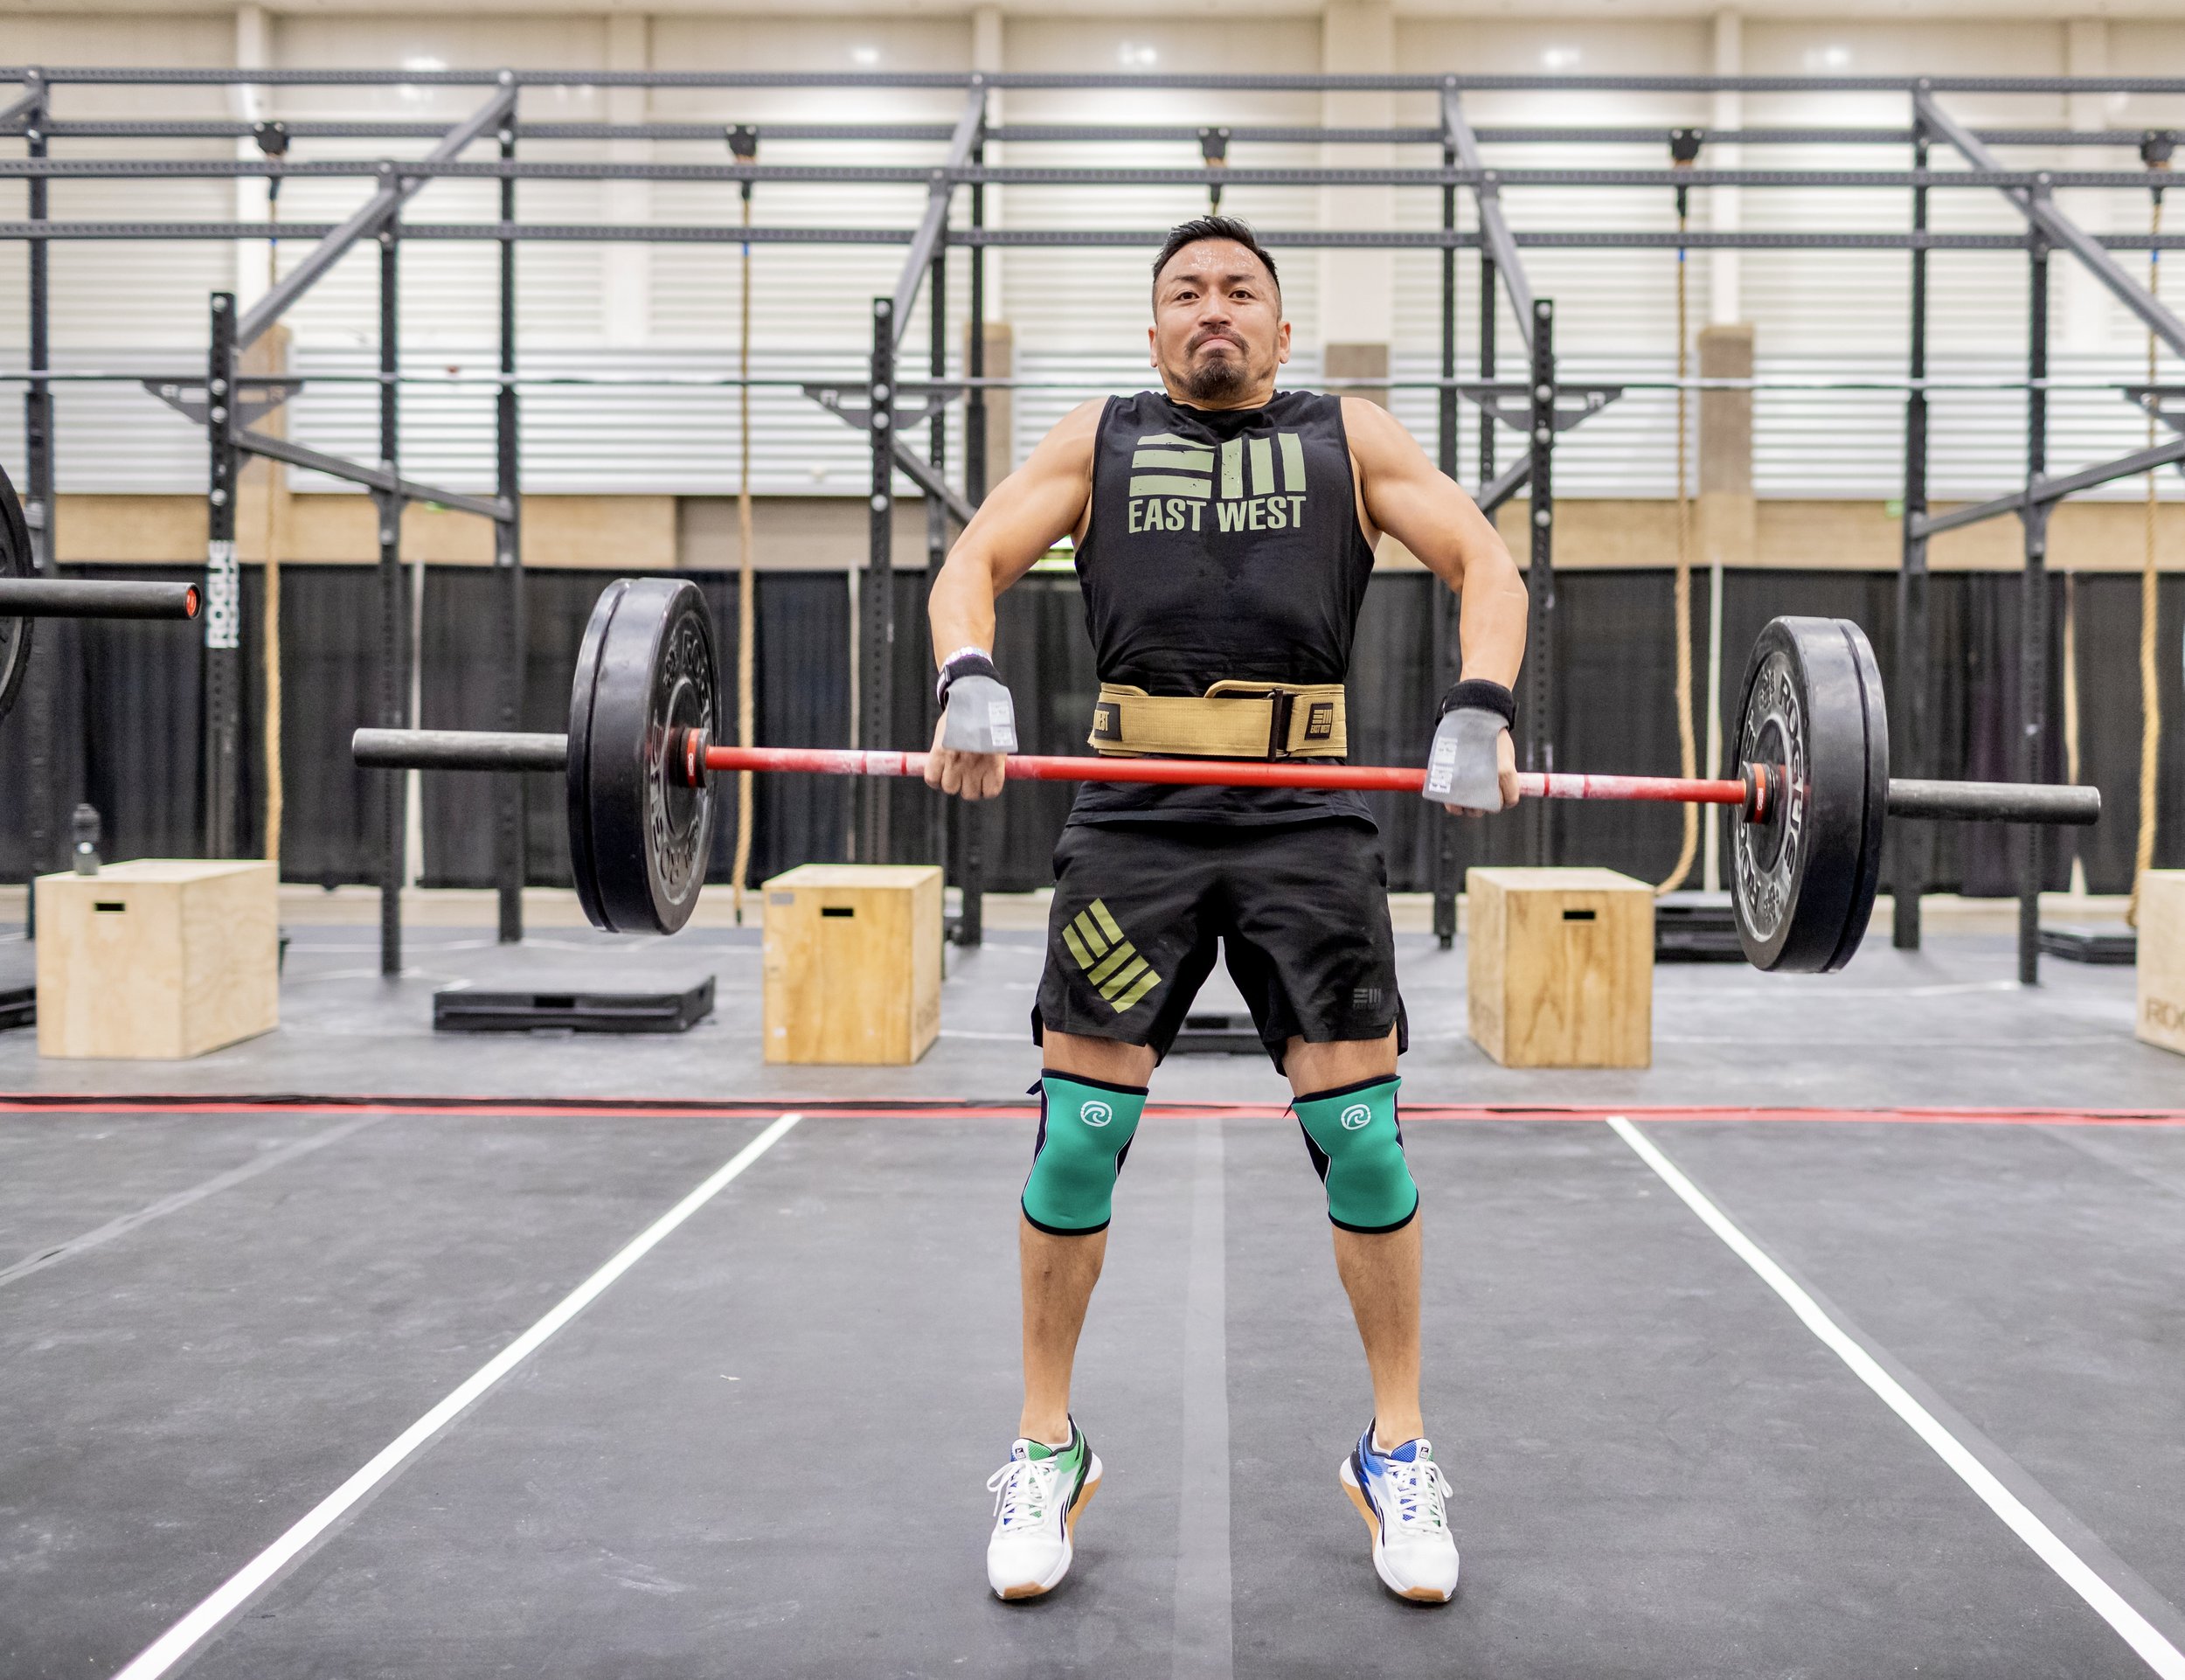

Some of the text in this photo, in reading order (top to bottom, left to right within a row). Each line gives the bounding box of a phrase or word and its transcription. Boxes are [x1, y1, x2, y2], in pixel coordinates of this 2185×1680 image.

[1128, 496, 1307, 533] EAST WEST
[207, 539, 230, 649] ROGUE
[1778, 670, 1804, 876] ROGUE
[2144, 996, 2185, 1034] RO
